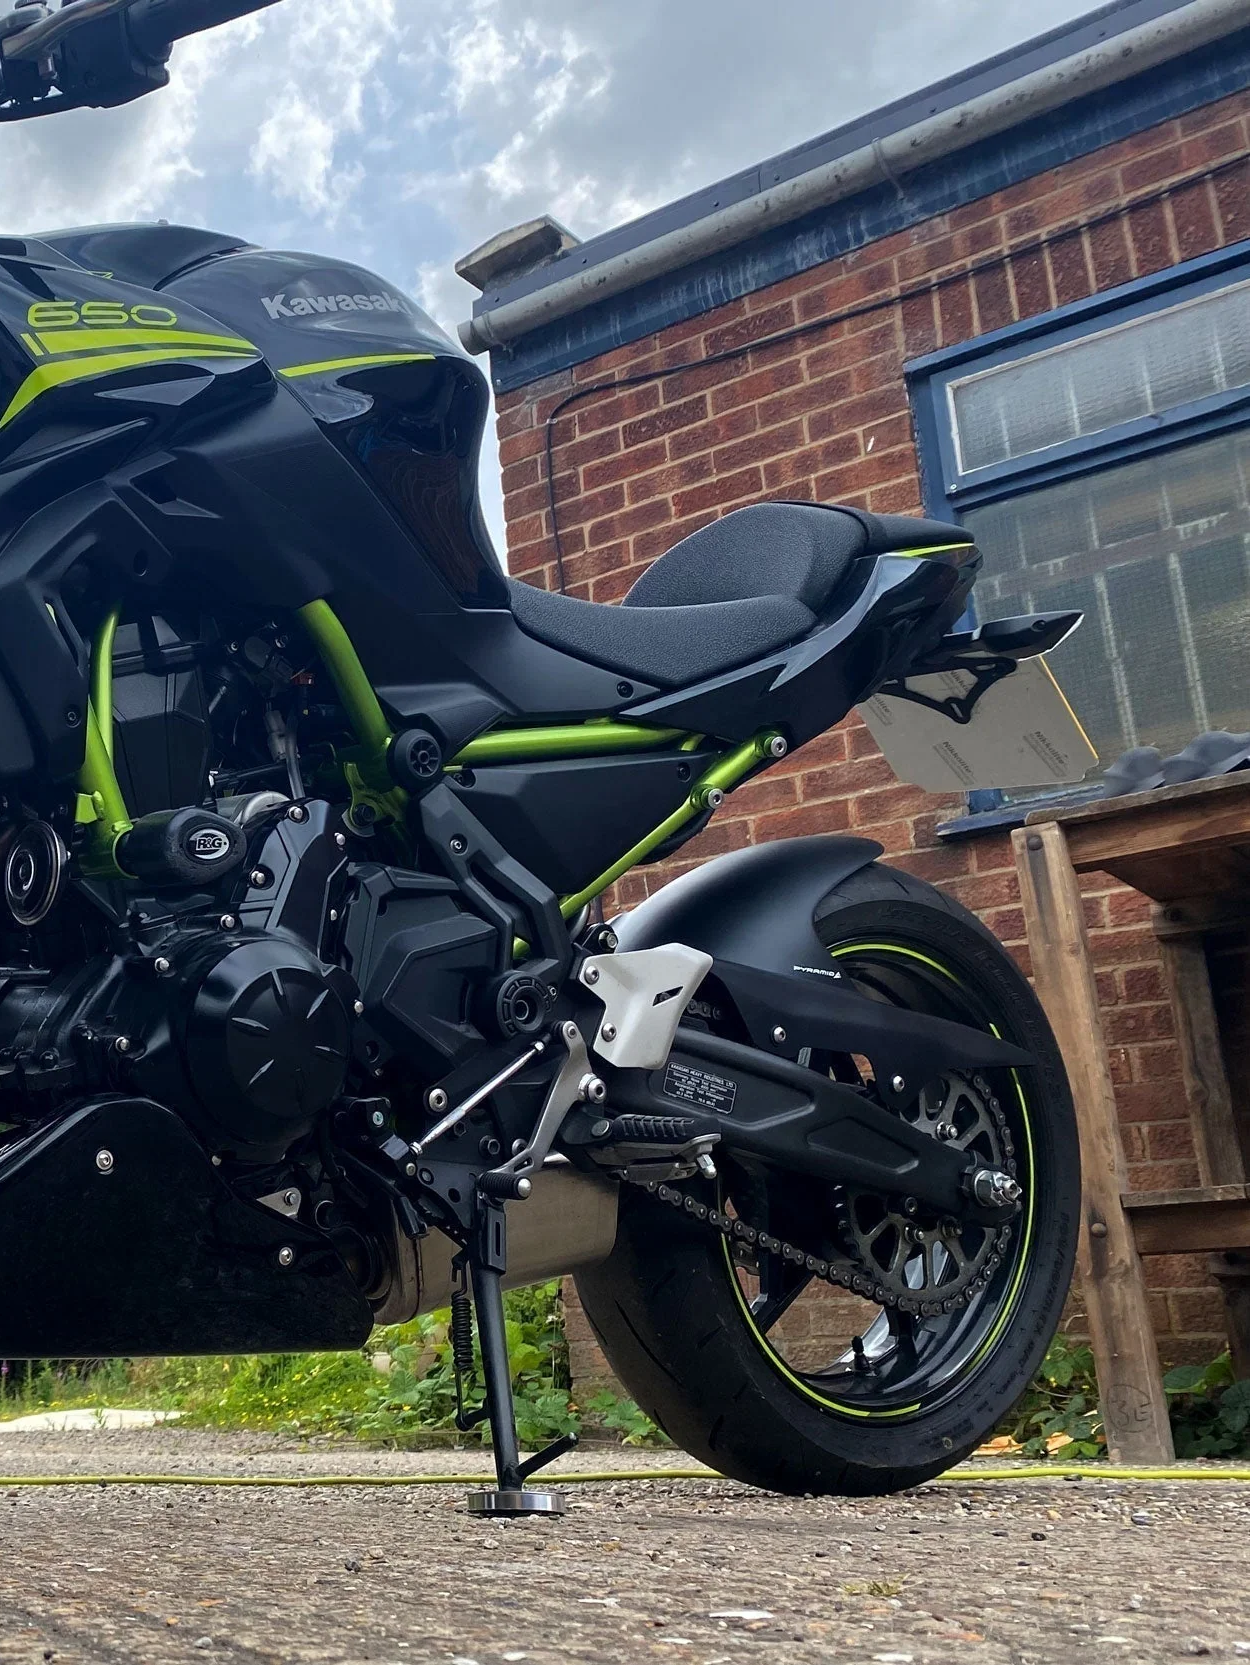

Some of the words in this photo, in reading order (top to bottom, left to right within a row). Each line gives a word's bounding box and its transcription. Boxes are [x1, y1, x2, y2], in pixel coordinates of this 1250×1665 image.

[28, 302, 178, 328] 650
[261, 292, 414, 320] Kawasaki
[196, 837, 223, 850] R&G
[793, 965, 835, 977] PYRAMID
